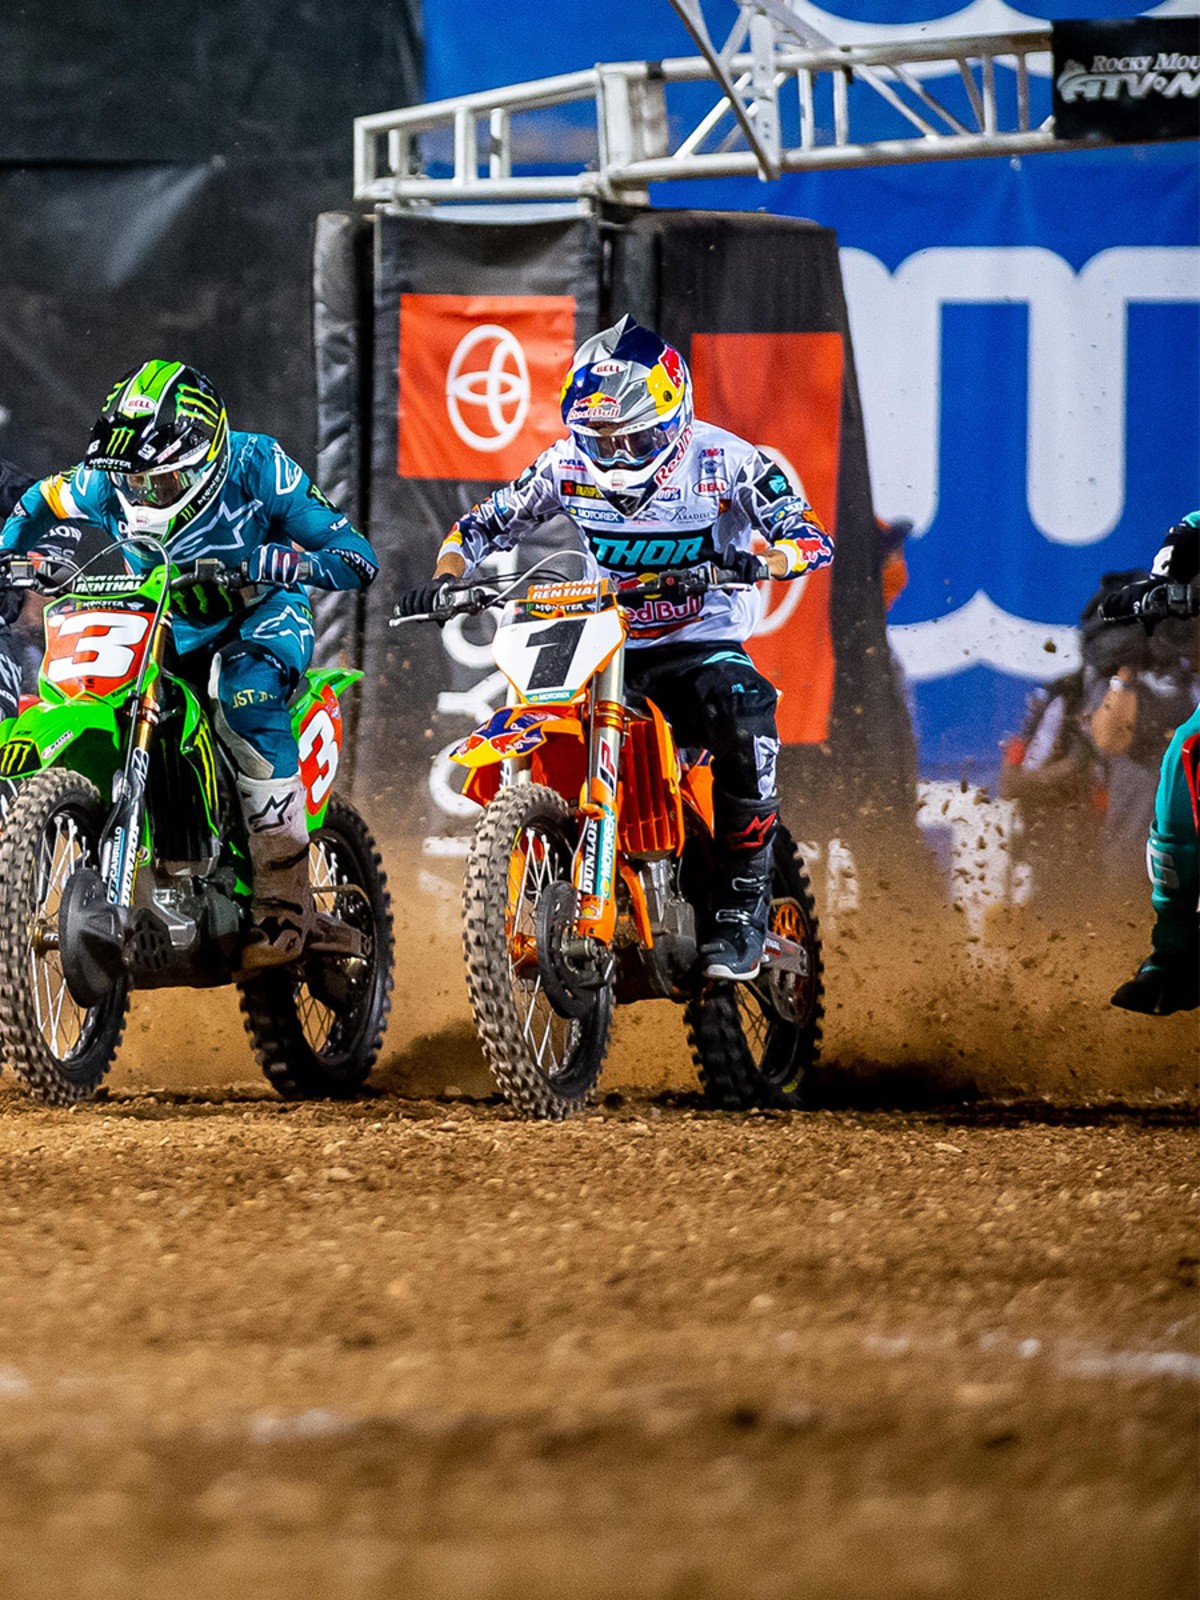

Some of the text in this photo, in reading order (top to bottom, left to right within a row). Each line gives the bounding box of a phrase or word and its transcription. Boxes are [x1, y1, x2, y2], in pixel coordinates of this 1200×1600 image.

[1091, 55, 1152, 72] ROCKY
[596, 365, 620, 373] BELL
[127, 398, 151, 408] BELL
[89, 456, 133, 469] MONSTER
[698, 481, 725, 495] BELL
[577, 508, 620, 522] MOTOREX
[592, 536, 704, 566] THOR
[75, 581, 142, 593] RENTHAL
[81, 600, 124, 608] MONSTER
[535, 603, 584, 612] MONSTER
[626, 601, 654, 623] ed
[46, 612, 149, 684] 3
[525, 618, 588, 691] 1
[299, 709, 340, 805] 3
[109, 826, 122, 880] CARRILLO
[600, 813, 616, 881] MOTOREX
[582, 820, 599, 896] DUNLOP
